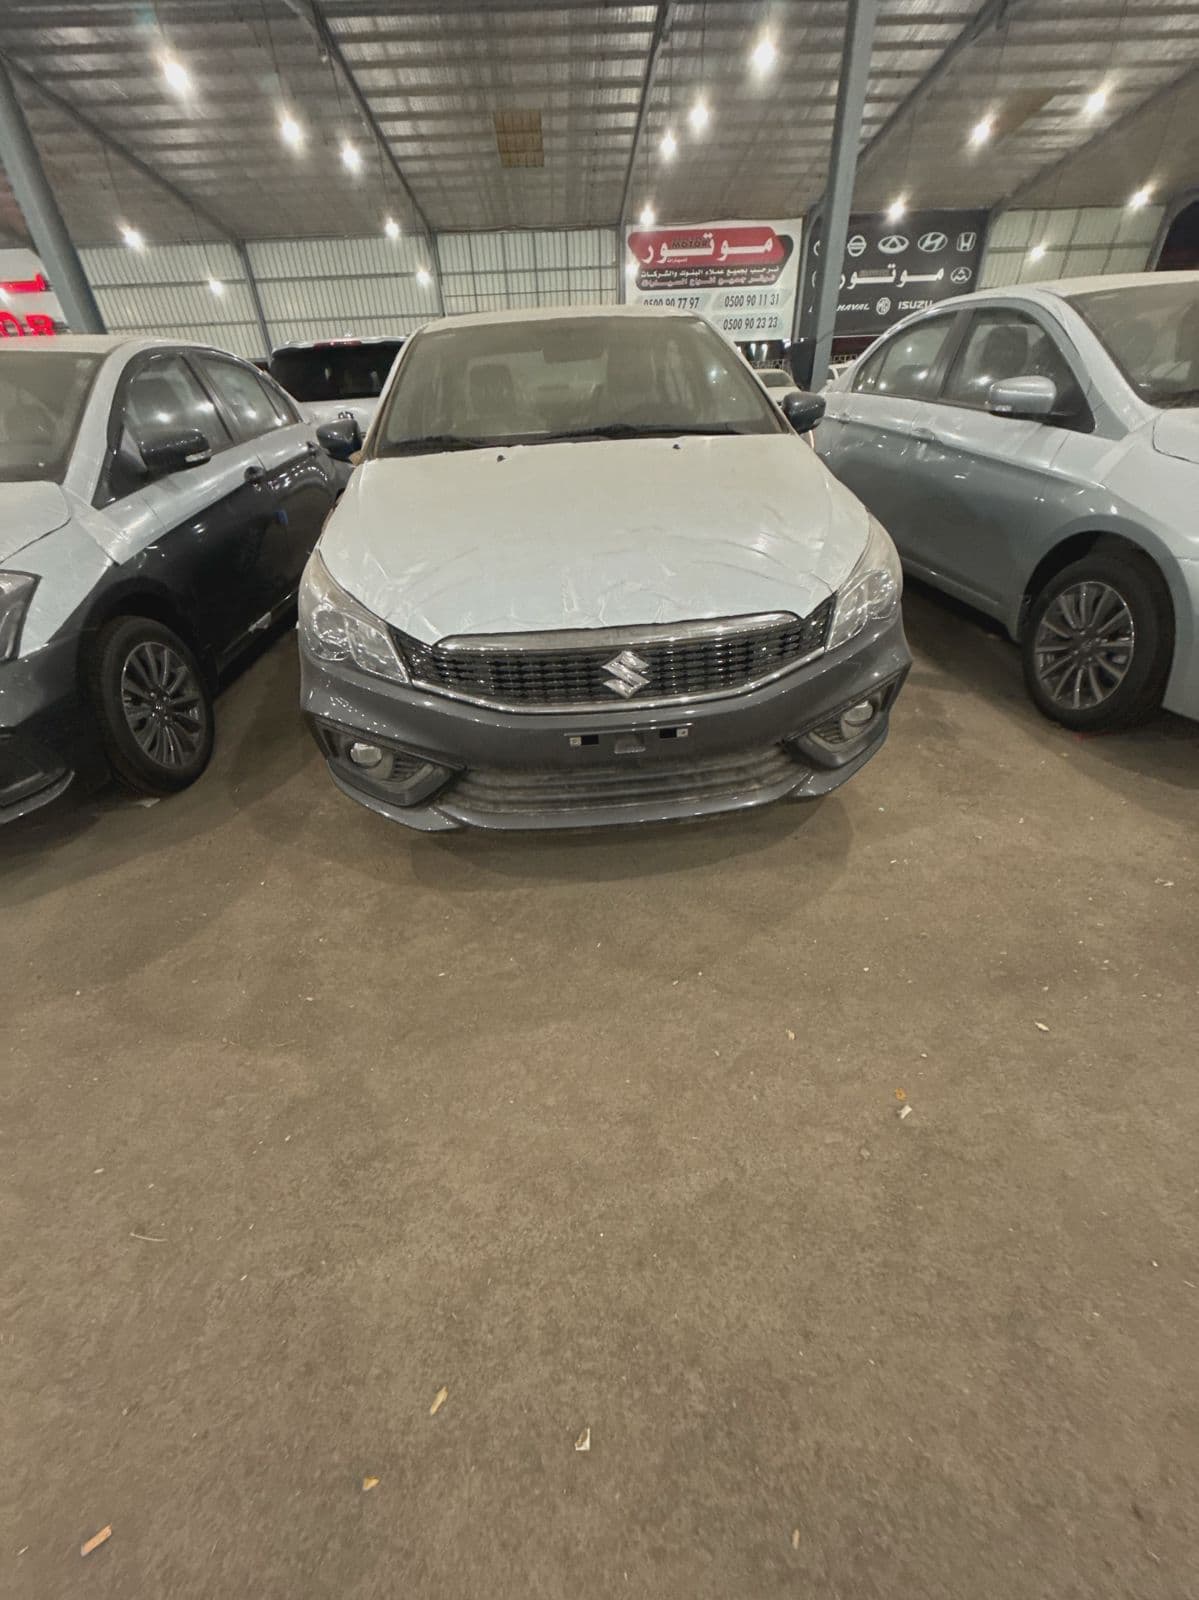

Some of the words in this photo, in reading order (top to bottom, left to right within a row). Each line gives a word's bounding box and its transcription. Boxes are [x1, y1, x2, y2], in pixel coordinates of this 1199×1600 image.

[677, 297, 687, 309] 77
[689, 296, 700, 309] 97
[724, 295, 744, 307] 0500
[746, 294, 757, 306] 90
[759, 294, 767, 305] 11
[770, 293, 780, 306] 31
[836, 303, 870, 312] HAVAL
[723, 319, 742, 330] 0500
[744, 318, 754, 330] 90
[756, 317, 766, 329] 23
[768, 316, 778, 329] 23
